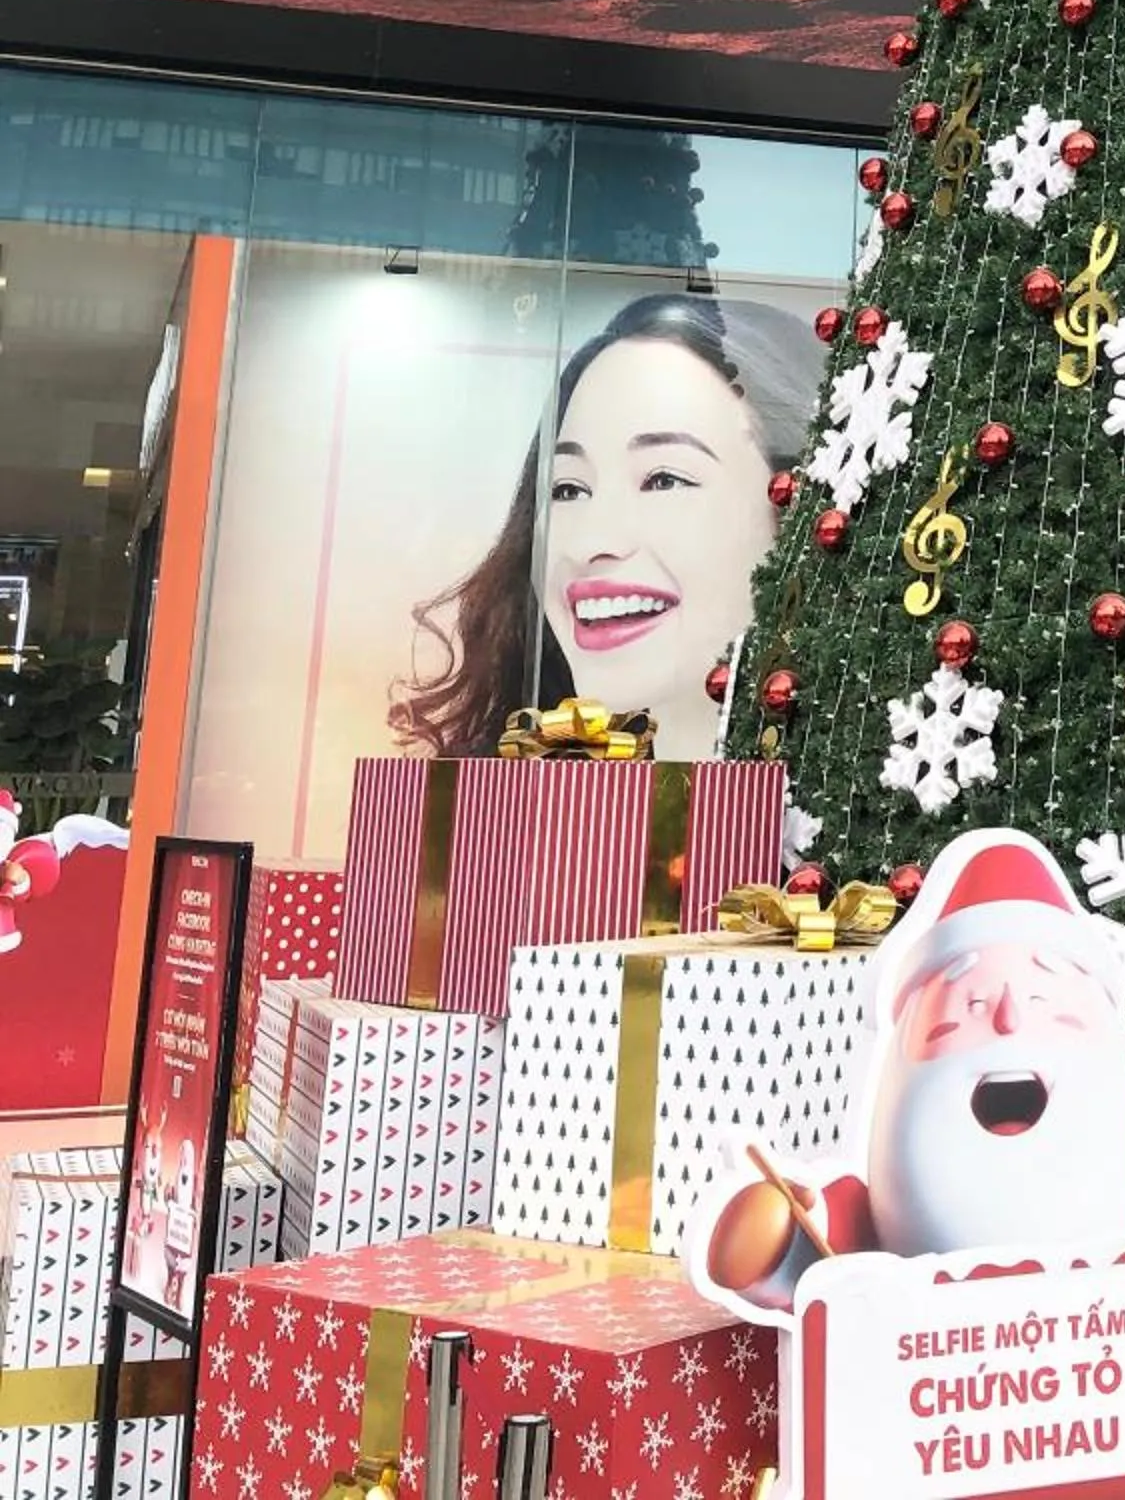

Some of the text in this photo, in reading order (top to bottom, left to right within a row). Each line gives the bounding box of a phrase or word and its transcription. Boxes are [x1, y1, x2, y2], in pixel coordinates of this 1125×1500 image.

[898, 1326, 985, 1361] SELFIE
[995, 1311, 1059, 1353] MỘT
[909, 1344, 1123, 1418] CHỨNG TỎ
[914, 1416, 1119, 1476] YÊU NHAU
